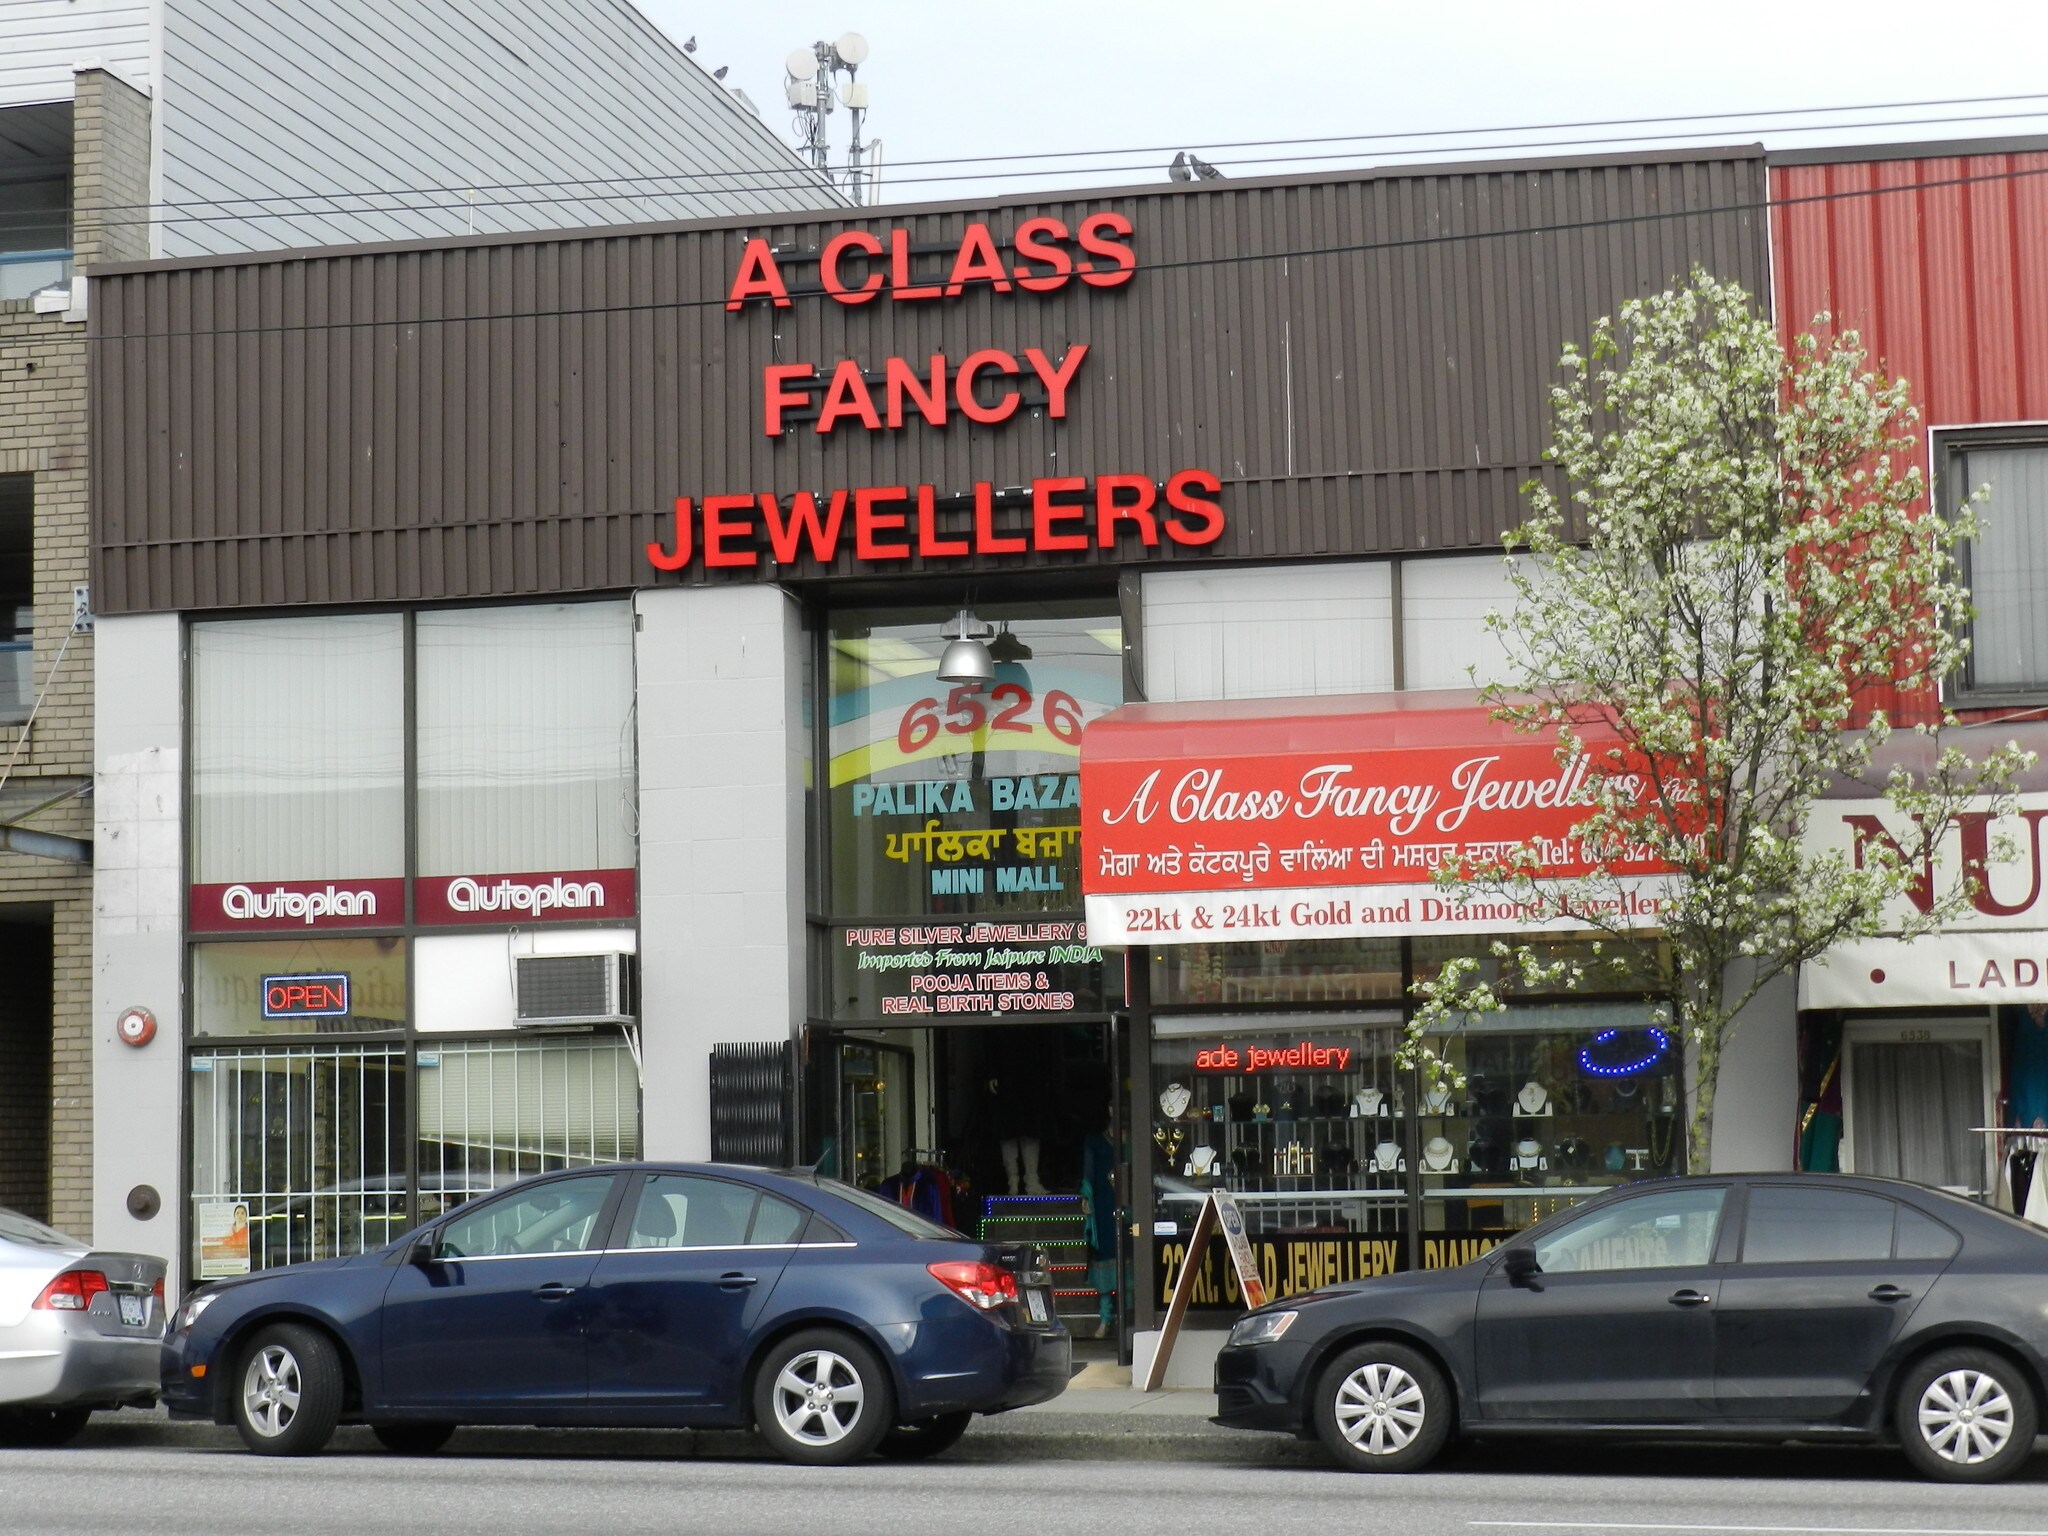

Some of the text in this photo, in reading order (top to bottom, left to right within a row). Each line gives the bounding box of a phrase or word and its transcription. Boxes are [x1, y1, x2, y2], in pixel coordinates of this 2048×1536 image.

[726, 212, 1136, 312] A CLASS
[764, 345, 1090, 437] FANCY
[647, 468, 1226, 572] JEWELLERS
[898, 683, 1084, 755] 6526
[853, 780, 974, 816] PALIKA
[1102, 769, 1161, 825] A
[1169, 768, 1292, 823] Class
[1295, 764, 1441, 836] Fancy
[886, 819, 1082, 863] ਪਾਲਿਕਾ ਬਜ਼ਾ
[1099, 845, 1140, 876] ਮੋਗਾ
[1147, 843, 1183, 875] ਅਤੇ
[1360, 837, 1384, 869] ਦੀ
[931, 866, 1064, 896] MINI MALL
[1126, 891, 1680, 933] 22kt & 24kt Gold and Diamond Jeweller
[846, 928, 896, 947] PURE
[899, 926, 963, 944] SILVER
[965, 923, 1075, 943] JEWELLERY
[857, 946, 1103, 973] Imported From Jaipure INDIA
[268, 984, 343, 1010] OPEN
[911, 971, 1050, 992] POOJA ITEMS &
[882, 991, 1075, 1014] REAL BIRTH STONES
[1196, 1041, 1350, 1074] ade jewellery
[1224, 1242, 1277, 1304] GD
